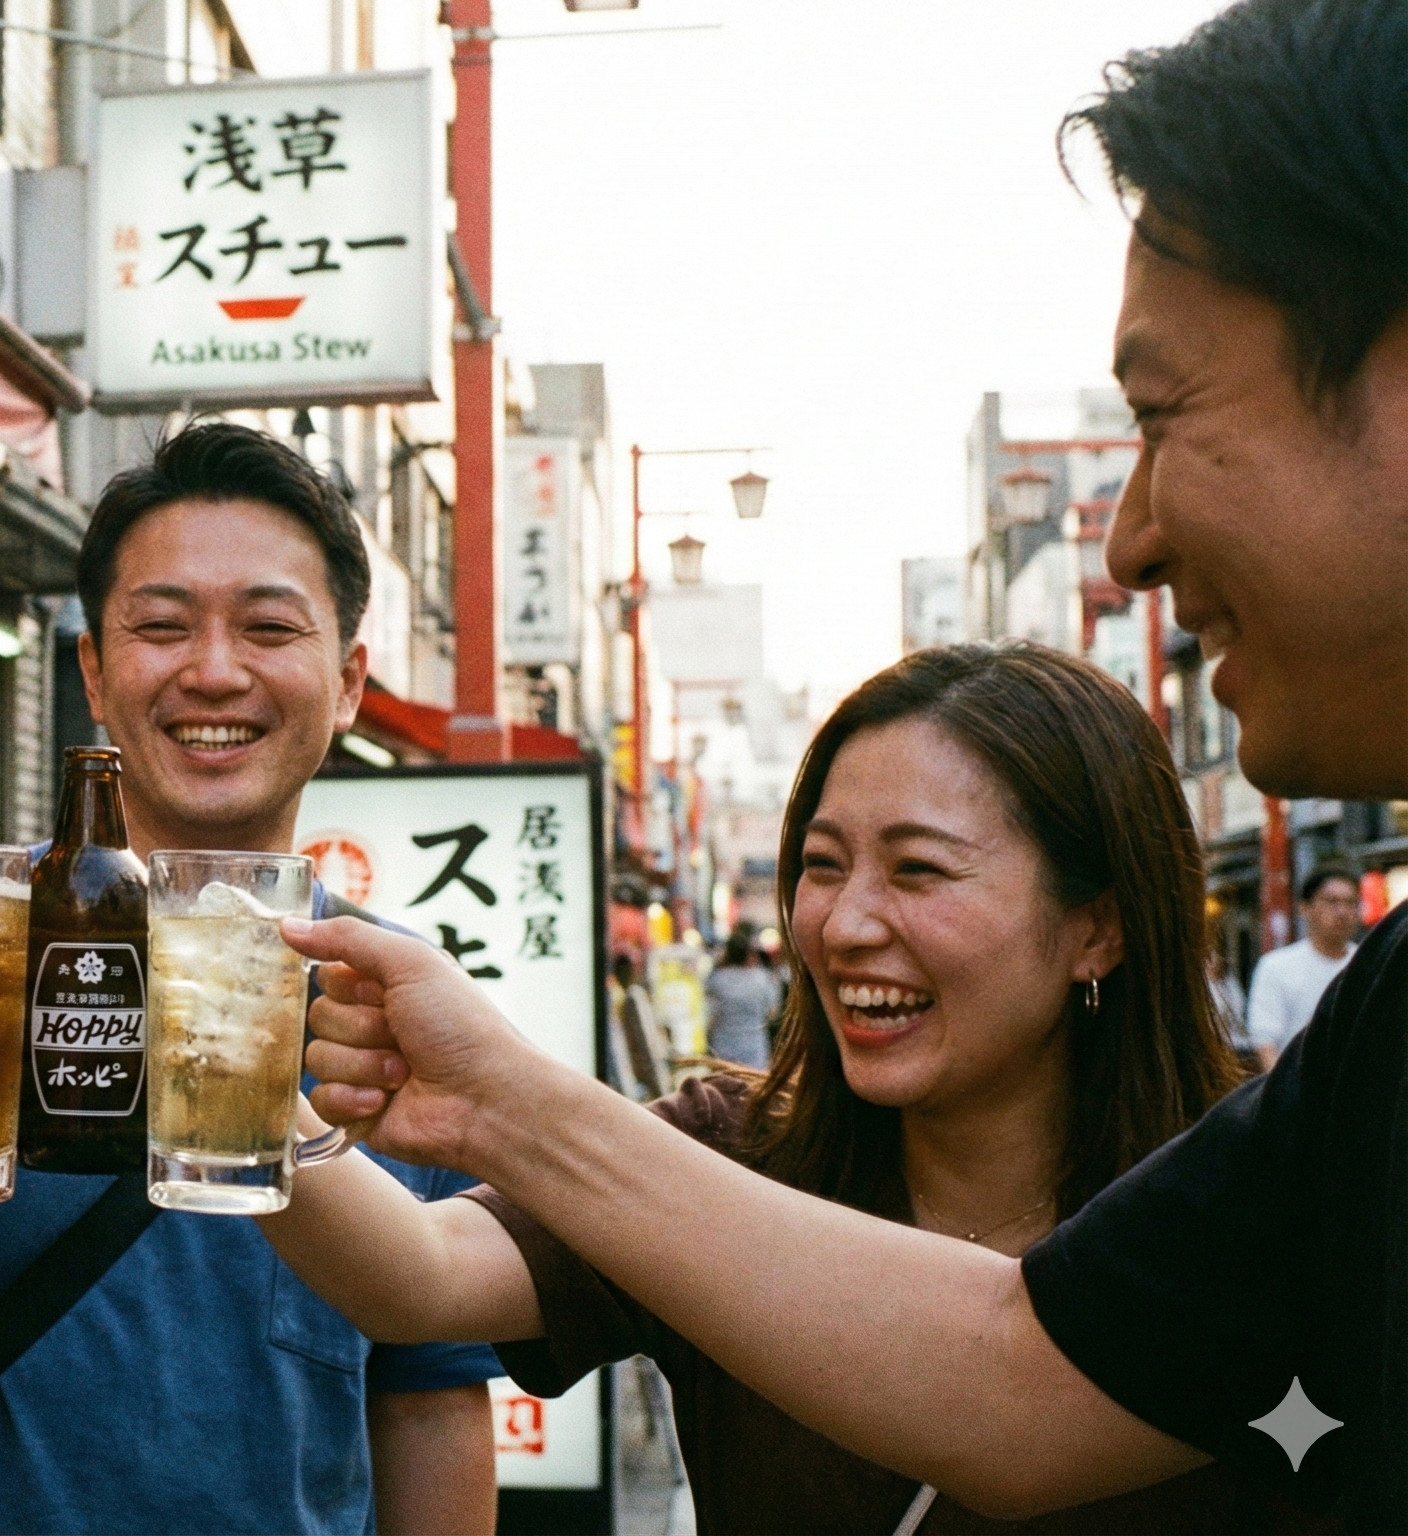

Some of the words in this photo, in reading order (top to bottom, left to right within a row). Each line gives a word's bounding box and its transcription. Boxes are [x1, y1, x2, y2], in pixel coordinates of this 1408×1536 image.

[182, 107, 348, 192] 浅草
[154, 214, 408, 285] スチュー
[151, 336, 282, 367] Asakusa
[294, 332, 372, 362] Stew
[47, 1057, 129, 1088] ホッピー
